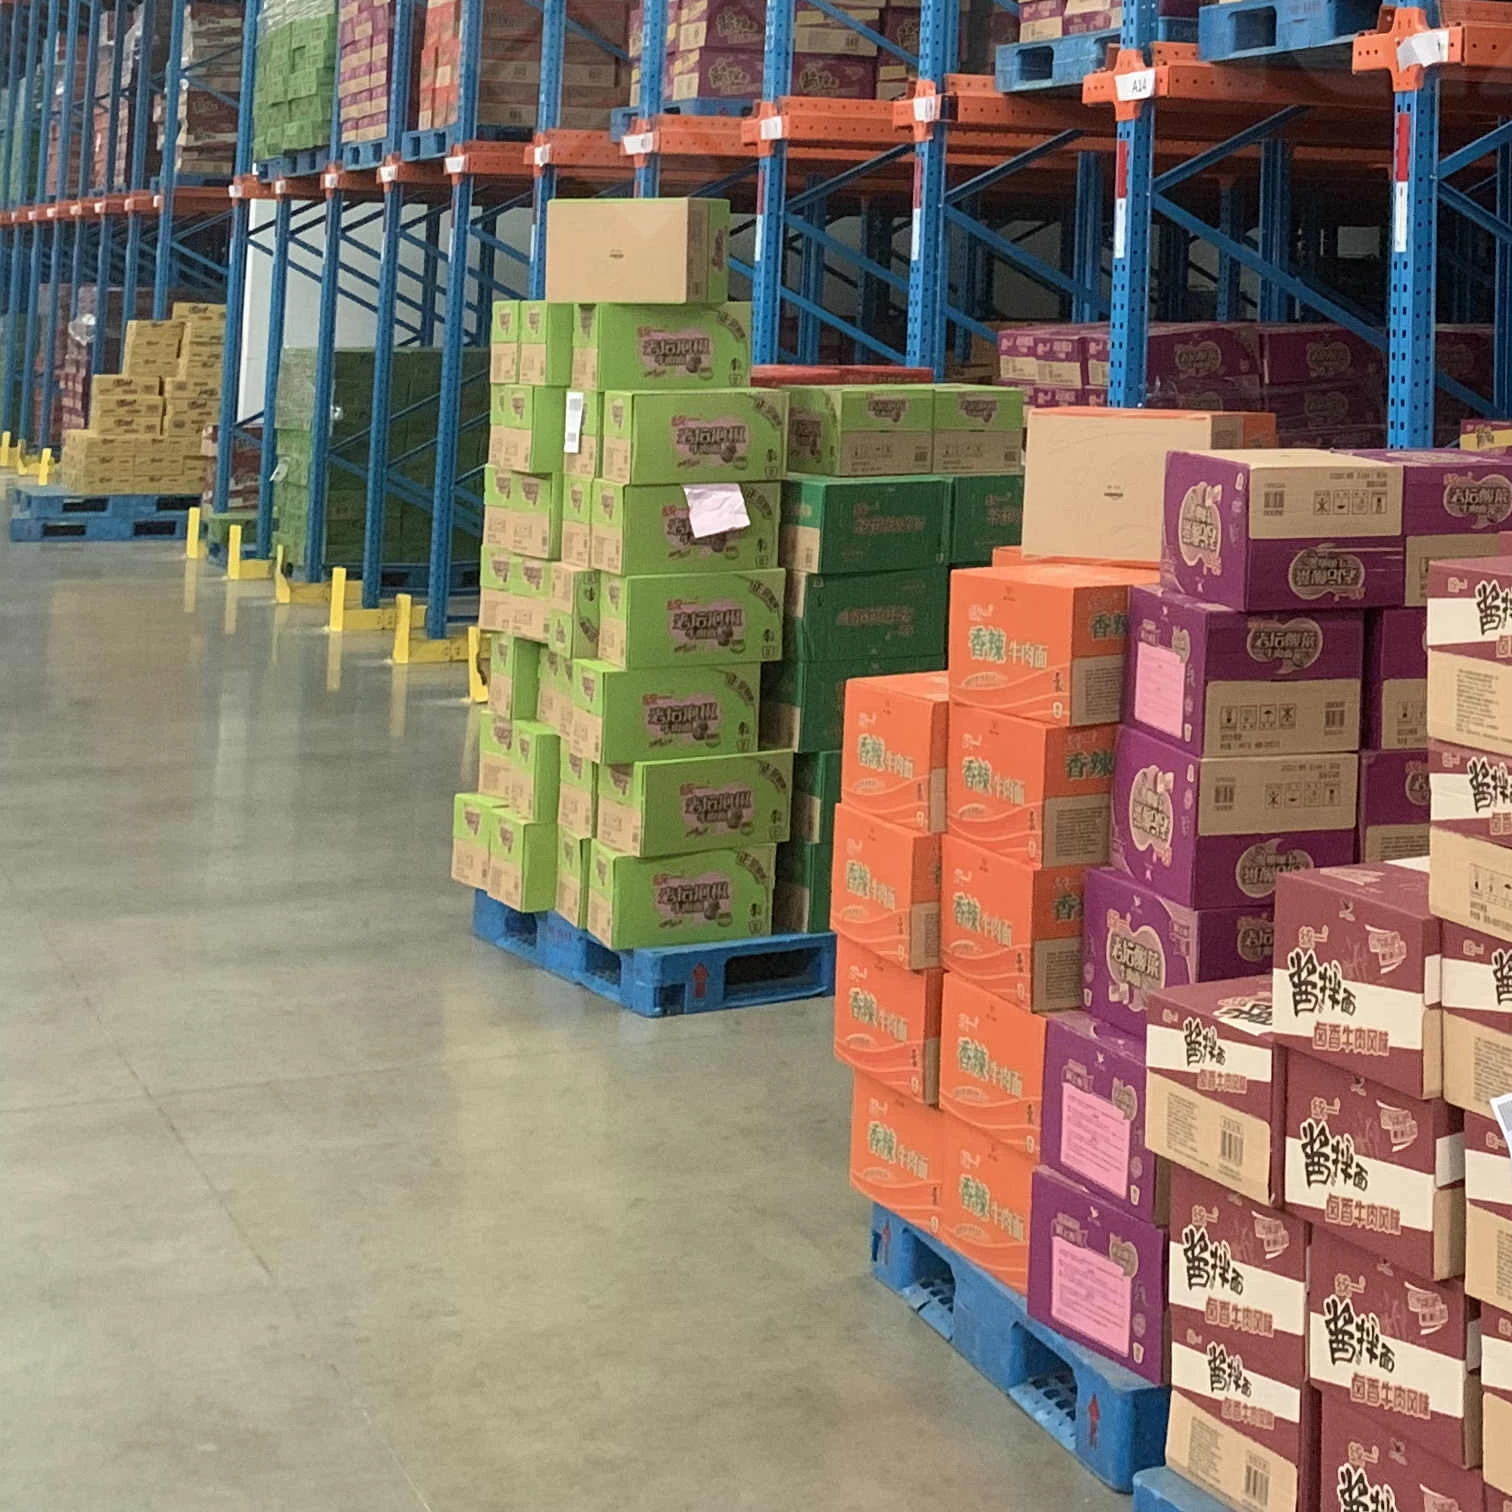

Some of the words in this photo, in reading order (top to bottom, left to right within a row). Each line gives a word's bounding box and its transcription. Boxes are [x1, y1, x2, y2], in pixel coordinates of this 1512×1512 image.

[968, 626, 1048, 669] 香辣牛肉面
[1289, 948, 1357, 1018] 酱拌面
[1183, 1018, 1226, 1065] 酱拌面
[1313, 1020, 1390, 1055] 卤香牛肉风味
[1302, 1119, 1369, 1191] 酱拌面
[1325, 1193, 1402, 1234] 卤香牛肉风味
[1183, 1227, 1244, 1295] 酱拌面
[1205, 1296, 1274, 1337] 卤香牛肉风味
[1324, 1295, 1395, 1372] 酱拌面
[1208, 1342, 1252, 1398] 酱拌面
[1352, 1374, 1432, 1420] 卤香牛肉风味
